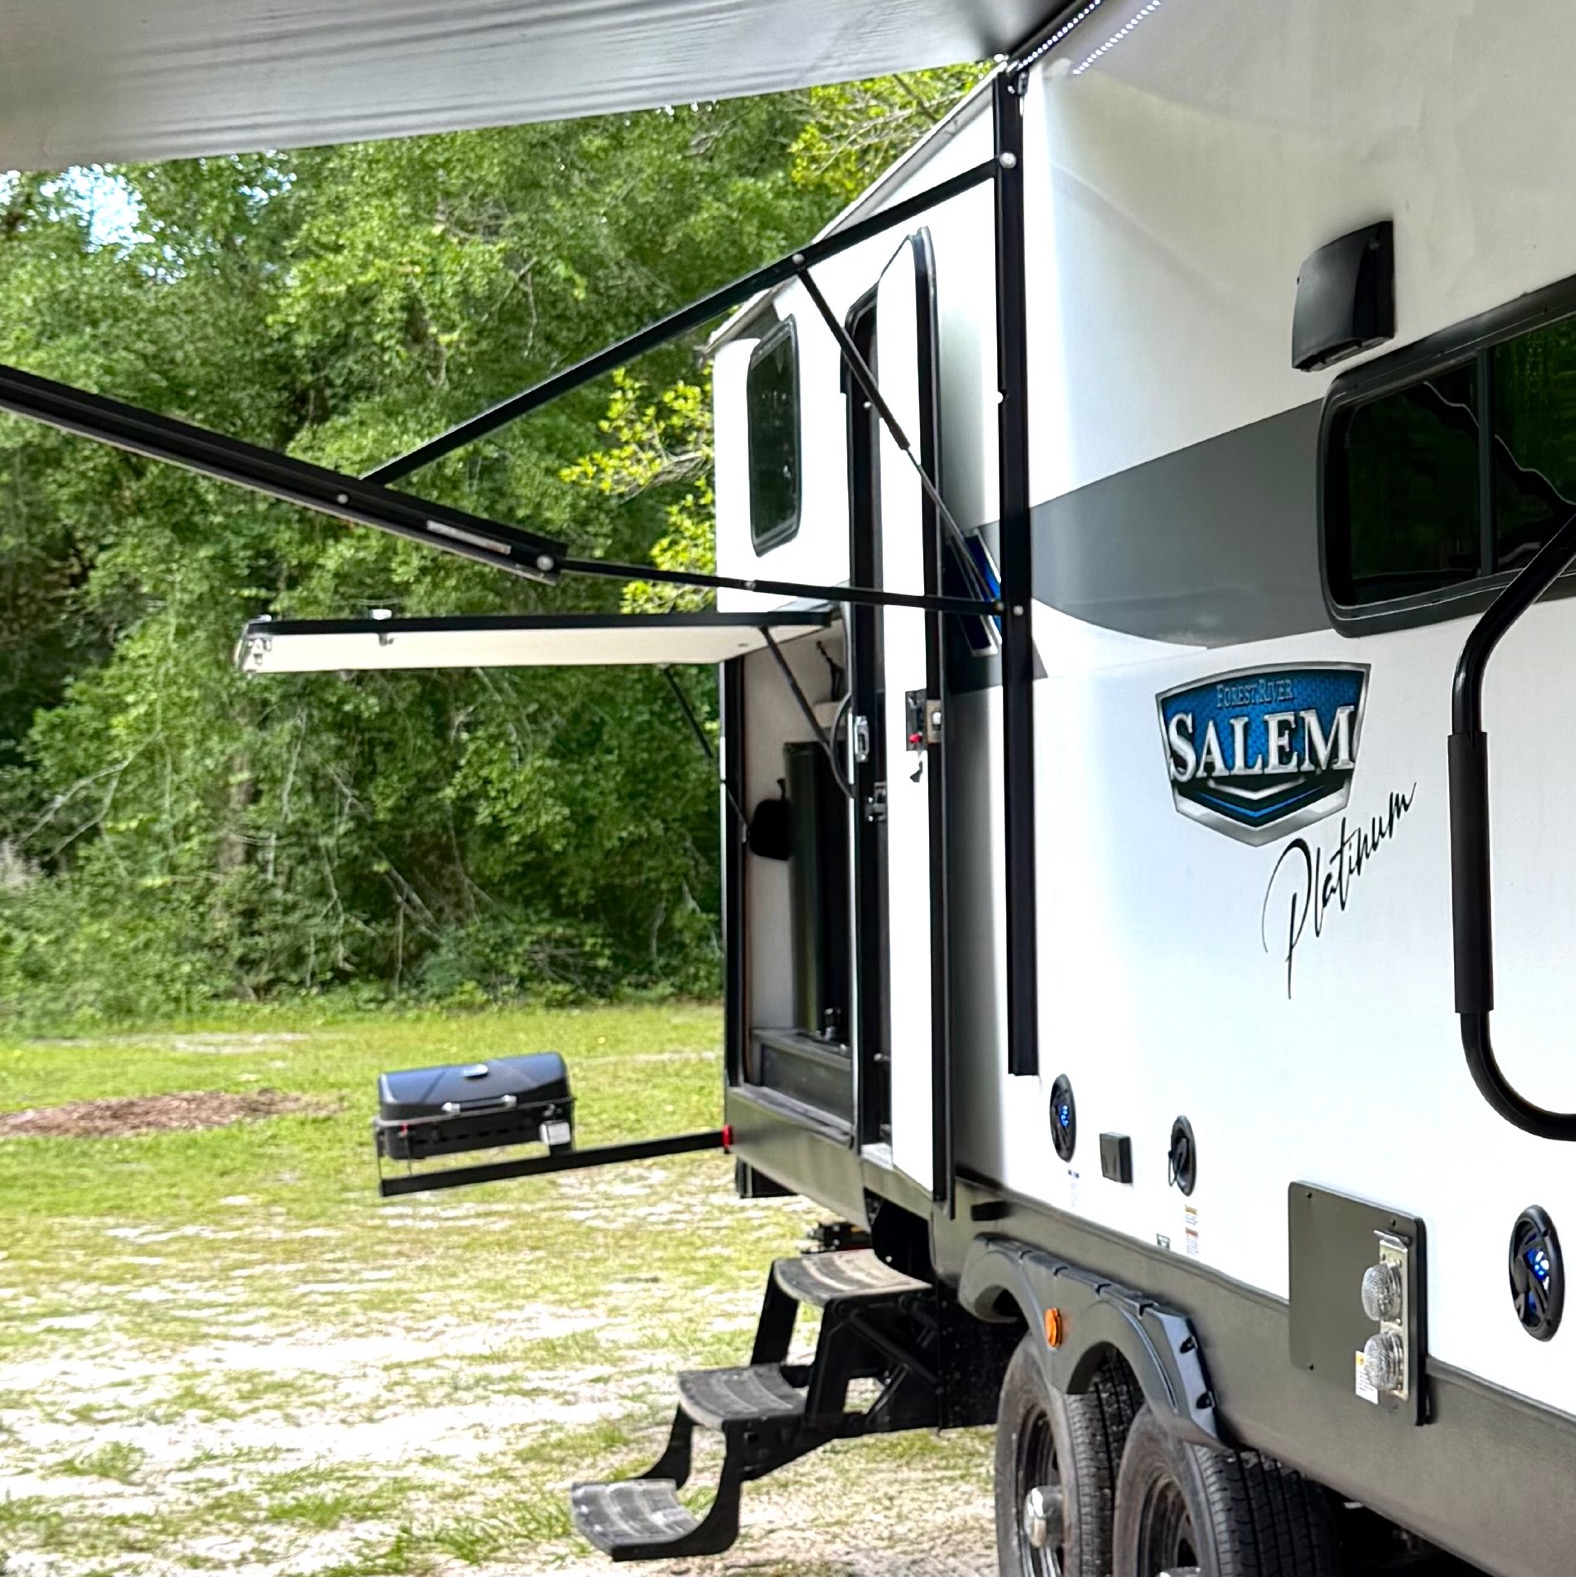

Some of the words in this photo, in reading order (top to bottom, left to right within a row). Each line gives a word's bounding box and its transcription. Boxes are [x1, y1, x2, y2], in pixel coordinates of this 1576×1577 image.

[1258, 679, 1294, 703] RIVER
[1168, 705, 1355, 782] SALEM
[1261, 782, 1417, 1000] Platinum
